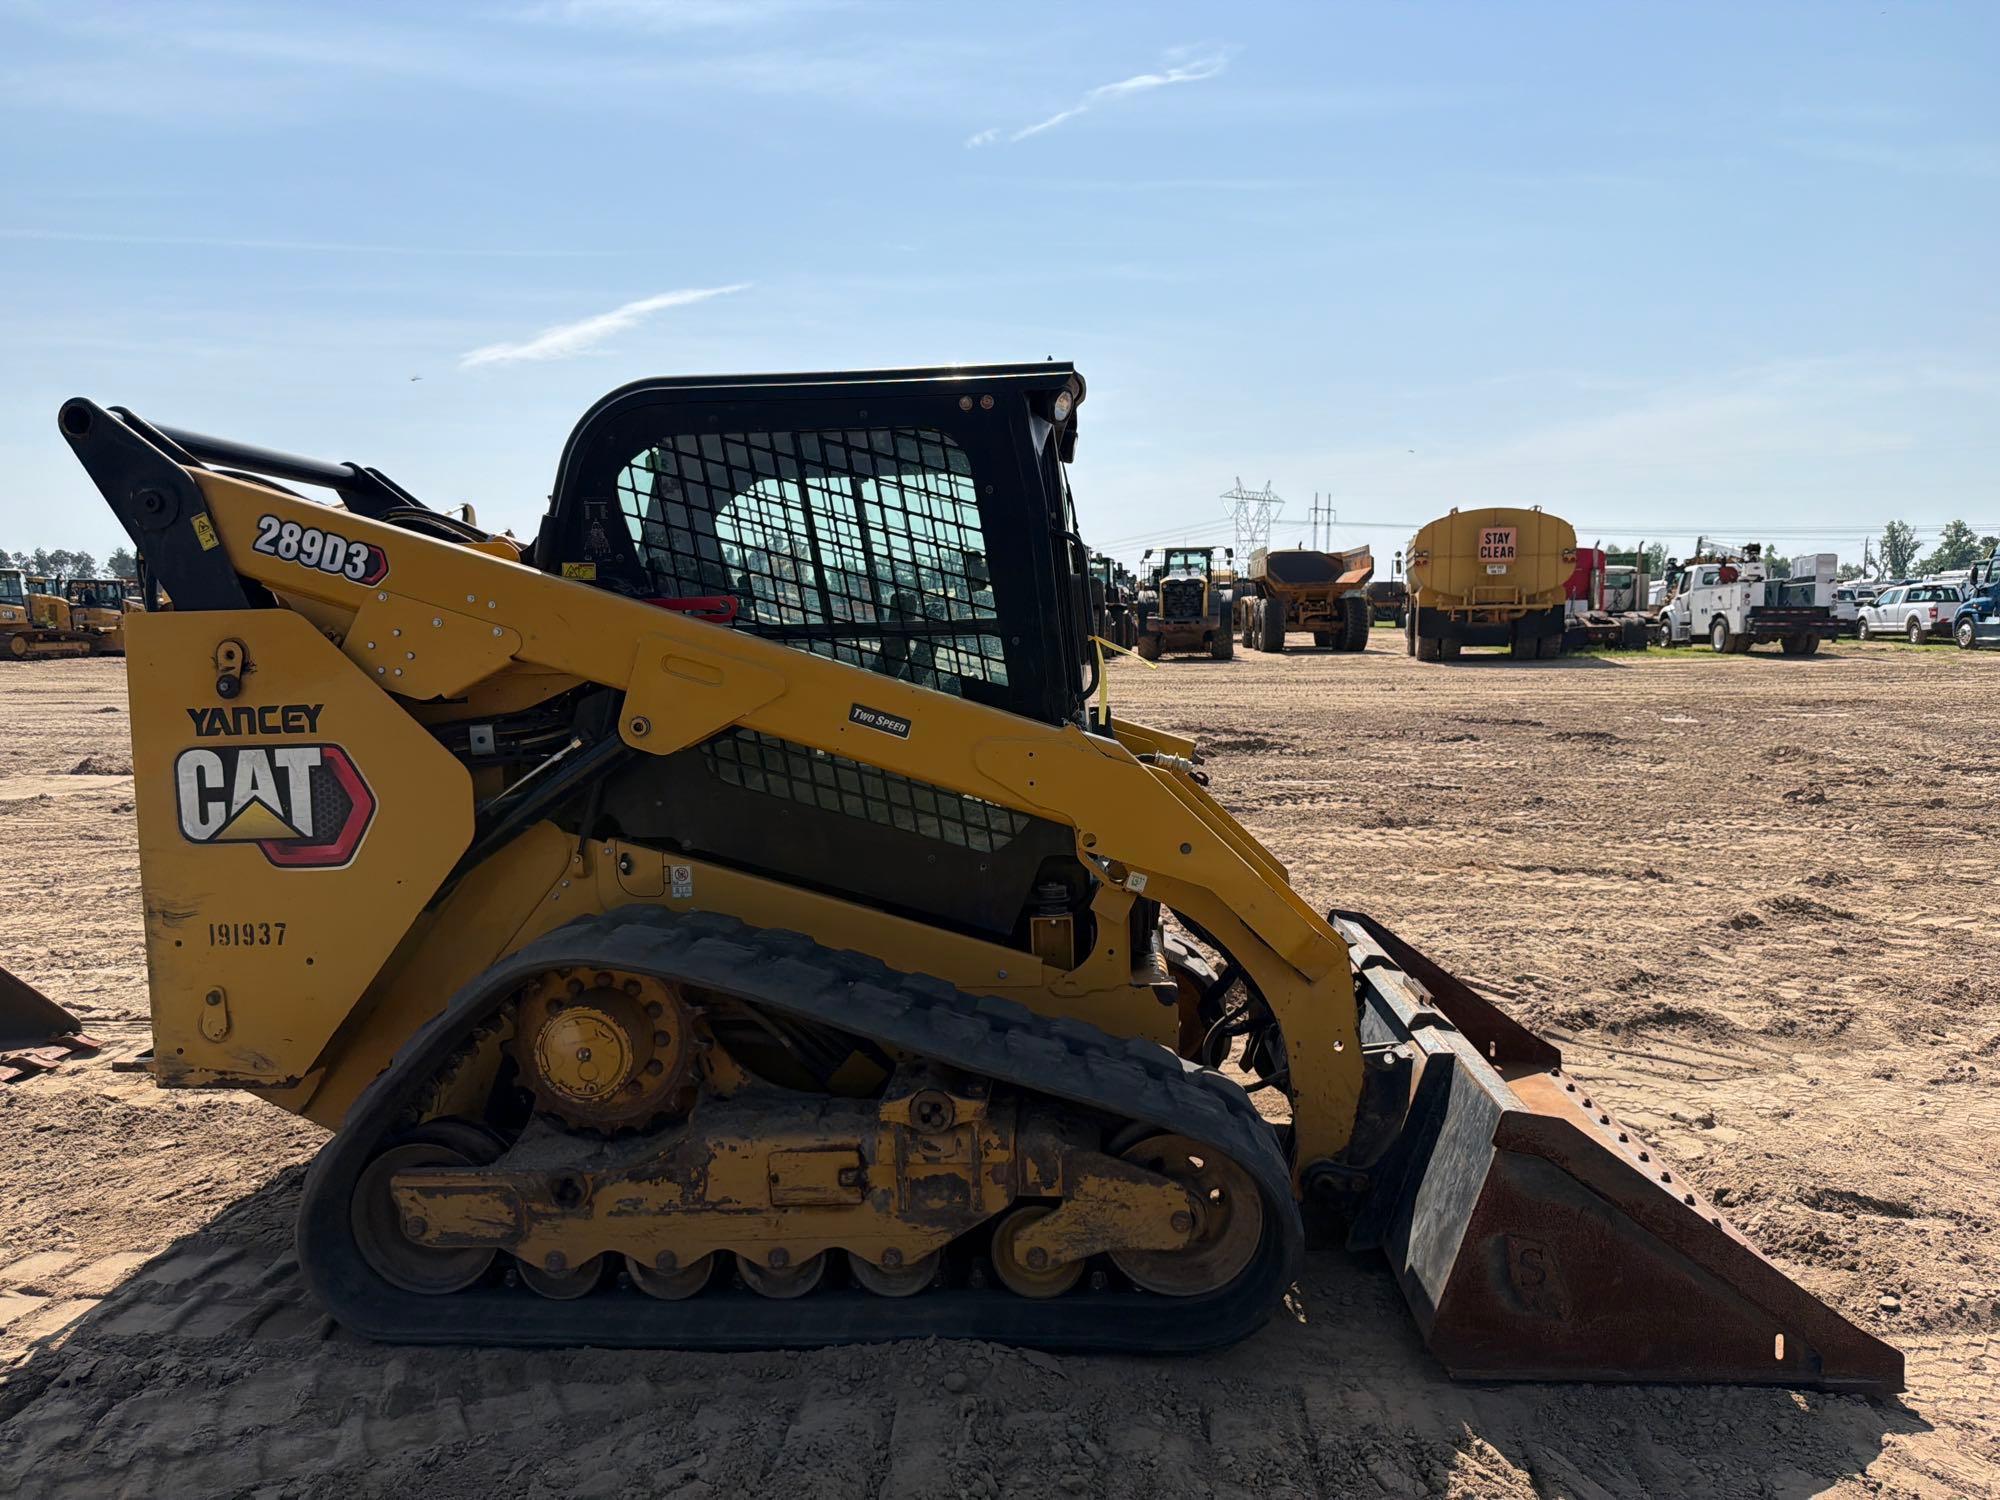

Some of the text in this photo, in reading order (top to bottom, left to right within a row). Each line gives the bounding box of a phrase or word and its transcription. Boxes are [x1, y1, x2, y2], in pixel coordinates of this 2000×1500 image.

[253, 515, 369, 579] 289D3
[1480, 546, 1514, 558] CLEAR
[1485, 532, 1510, 545] STAY
[187, 704, 324, 736] YANCEY
[177, 747, 322, 840] CAT
[209, 922, 287, 946] 191937
